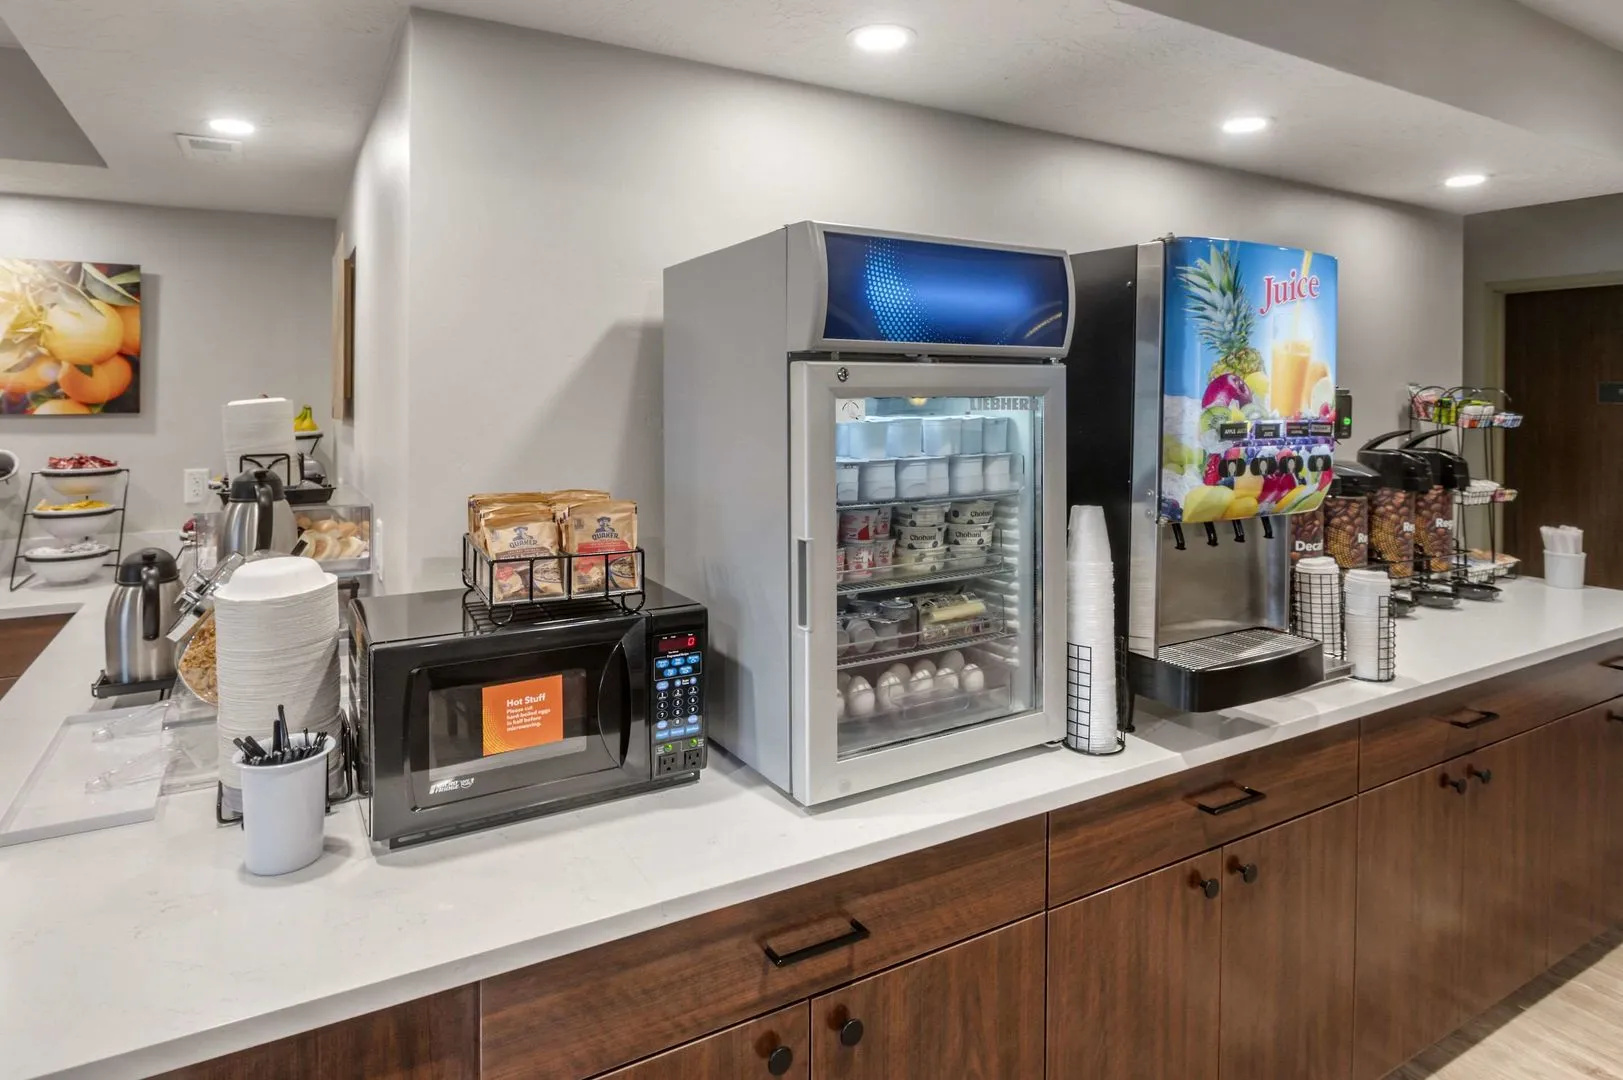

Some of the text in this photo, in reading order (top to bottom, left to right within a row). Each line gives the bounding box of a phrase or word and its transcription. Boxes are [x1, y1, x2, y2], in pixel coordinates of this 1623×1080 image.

[1260, 269, 1320, 315] Juice
[591, 532, 620, 541] QUAKER
[509, 539, 538, 549] QUAKER
[687, 637, 695, 646] 0
[506, 692, 546, 707] Hot Stuff
